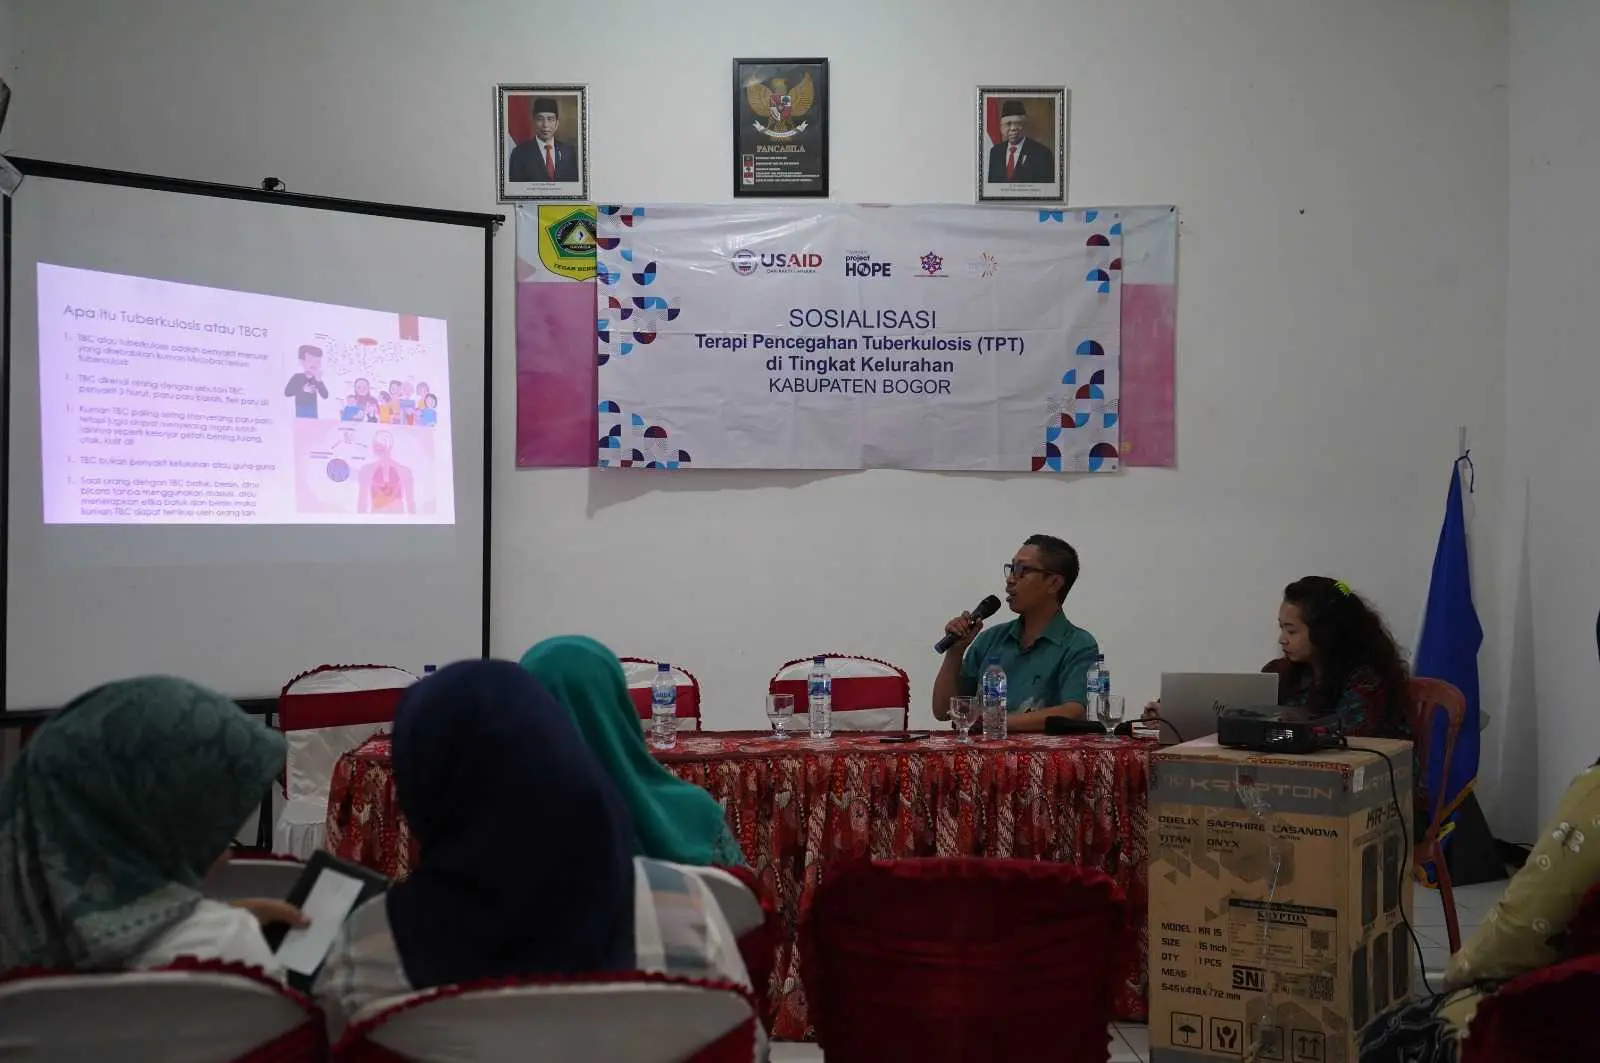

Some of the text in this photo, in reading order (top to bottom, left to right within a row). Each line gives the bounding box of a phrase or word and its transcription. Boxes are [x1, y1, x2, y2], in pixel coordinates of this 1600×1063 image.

[756, 145, 806, 153] PANCASILA
[760, 253, 823, 268] USAID
[845, 255, 871, 263] project
[845, 262, 892, 277] HOPE
[64, 304, 269, 339] Apa itu Tuberkulosis atau TBC?
[789, 308, 937, 329] SOSIALISASI
[695, 333, 1025, 355] Terapi Pencegahan Tuberkulosis (TPT)
[766, 356, 954, 374] di Tingkat Kelurahan
[768, 378, 951, 394] KABUPATEN BOGOR
[1190, 776, 1334, 800] KRPTON
[1206, 818, 1266, 833] SAPPHIRE
[1272, 823, 1339, 839] CASANOVA
[1159, 833, 1241, 849] TITAN ONYX
[1161, 921, 1191, 934] MODEL
[1161, 937, 1181, 948] SIZE
[1161, 953, 1179, 963] QTY
[1203, 957, 1222, 968] PCS
[1226, 991, 1241, 1001] mm
